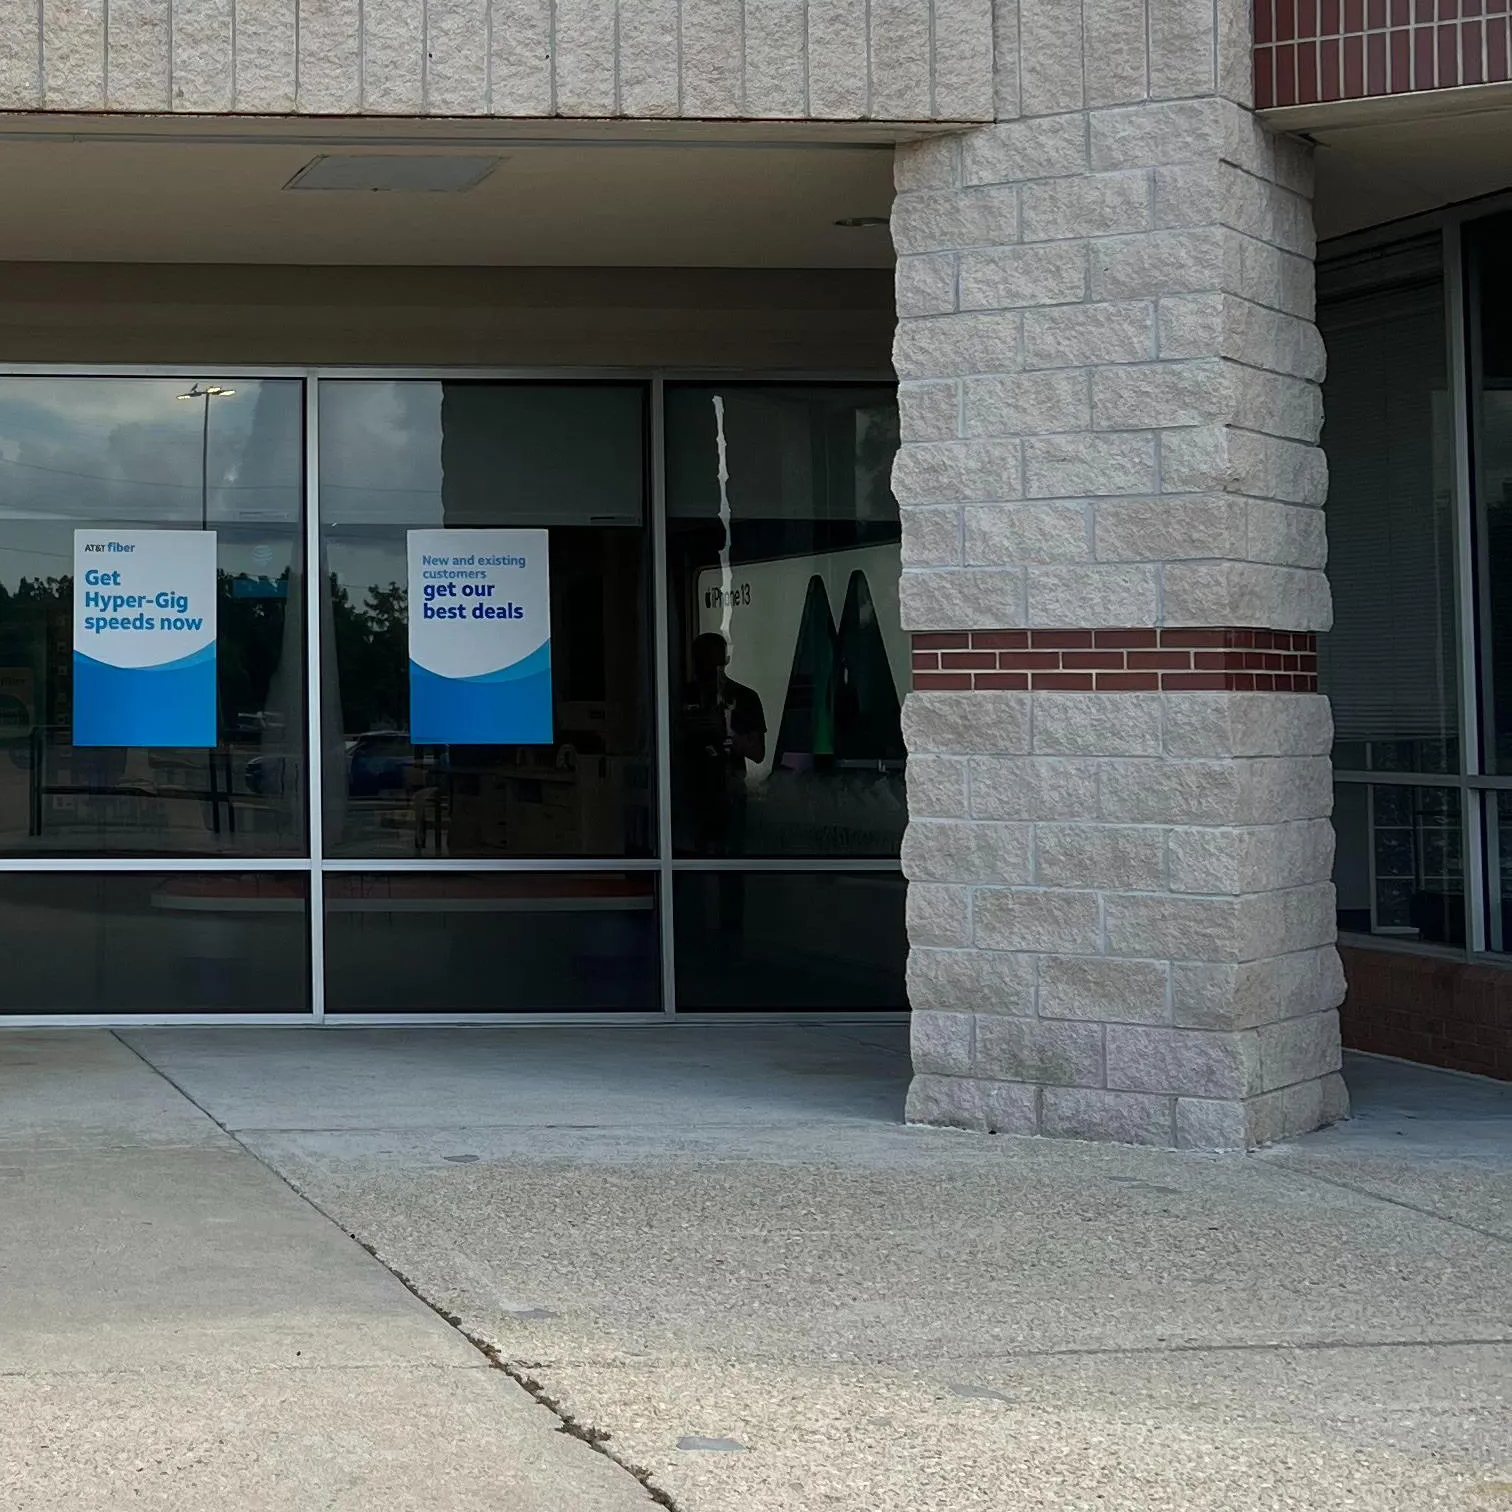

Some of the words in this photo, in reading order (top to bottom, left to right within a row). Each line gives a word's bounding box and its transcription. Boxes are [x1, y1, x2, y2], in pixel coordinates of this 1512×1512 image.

[84, 544, 105, 552] AT&T
[107, 542, 136, 552] fiber
[422, 555, 449, 566] New
[452, 554, 475, 566] and
[477, 554, 526, 569] existing
[85, 569, 121, 586] Get
[423, 569, 487, 579] customers
[423, 582, 457, 601] get
[461, 584, 496, 597] our
[85, 591, 188, 614] Hyper-Gig
[423, 602, 467, 619] best
[472, 602, 524, 619] deals
[84, 613, 155, 634] speeds
[160, 617, 203, 631] now
